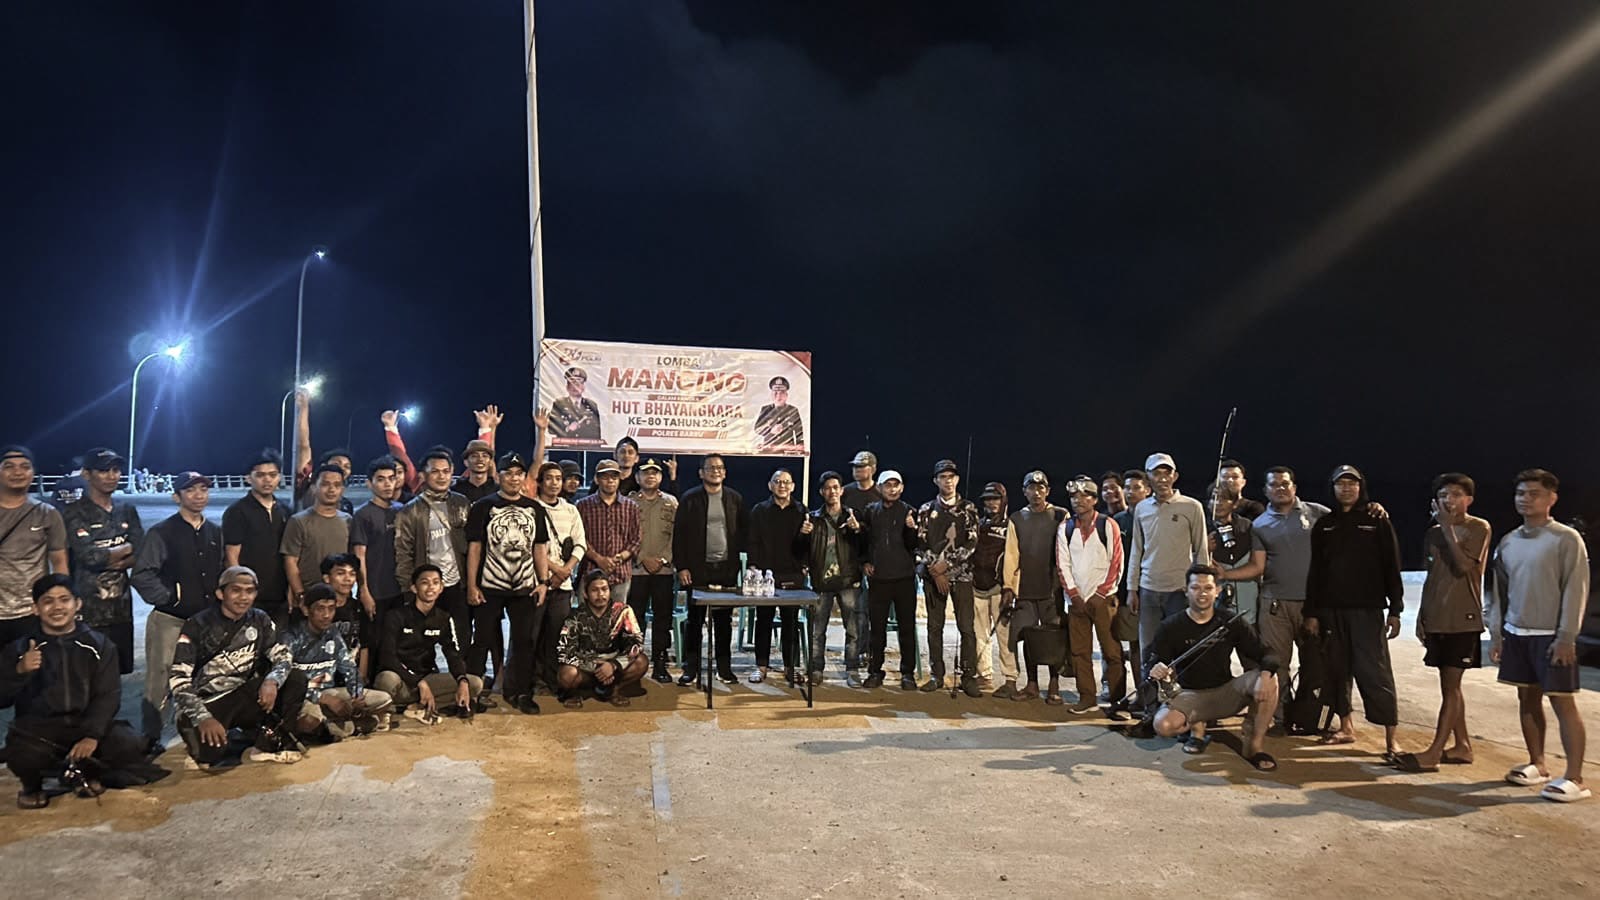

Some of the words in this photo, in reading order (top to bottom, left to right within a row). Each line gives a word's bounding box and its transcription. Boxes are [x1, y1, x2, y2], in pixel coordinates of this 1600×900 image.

[656, 355, 700, 367] LOMBA
[607, 367, 746, 393] MANCING
[612, 401, 640, 414] HUT
[644, 402, 743, 418] BHAYANGKARA
[628, 416, 662, 426] KE-80
[663, 417, 701, 428] TAHUN
[651, 429, 677, 438] POLRES
